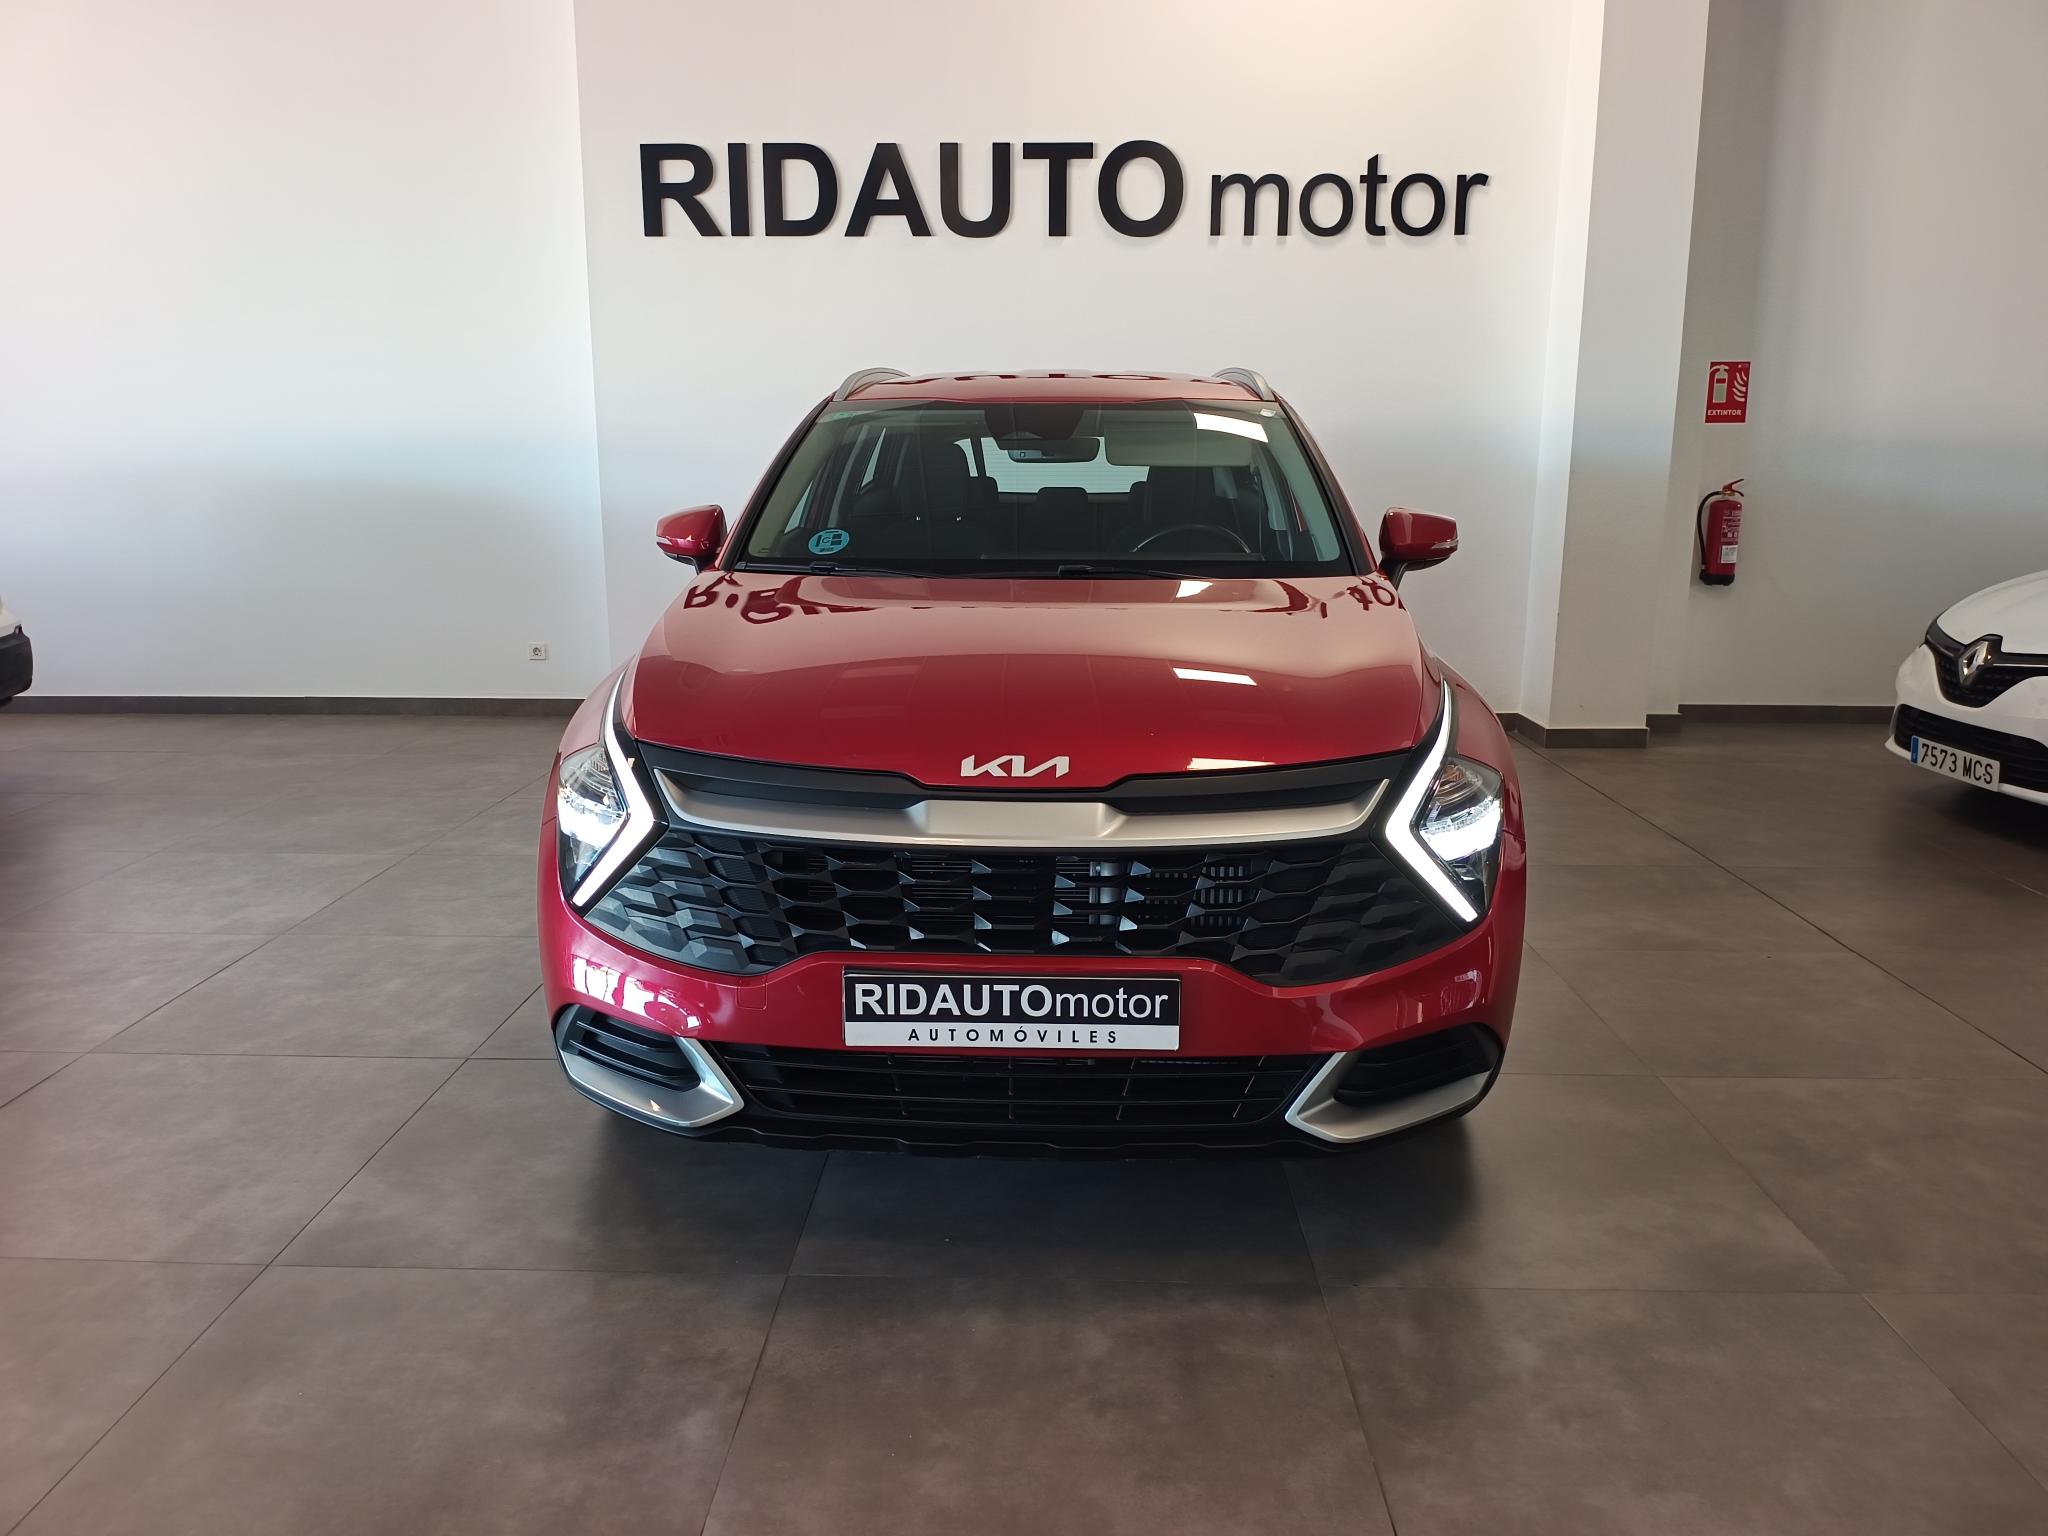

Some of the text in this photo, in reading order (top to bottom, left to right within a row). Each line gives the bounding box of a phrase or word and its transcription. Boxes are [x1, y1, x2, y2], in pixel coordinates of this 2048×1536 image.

[639, 140, 1490, 238] RIDAUTO motor
[960, 754, 1070, 778] KIA
[1920, 743, 1993, 785] 7573 MCS
[908, 1025, 1117, 1044] AUTOMÓVILES
